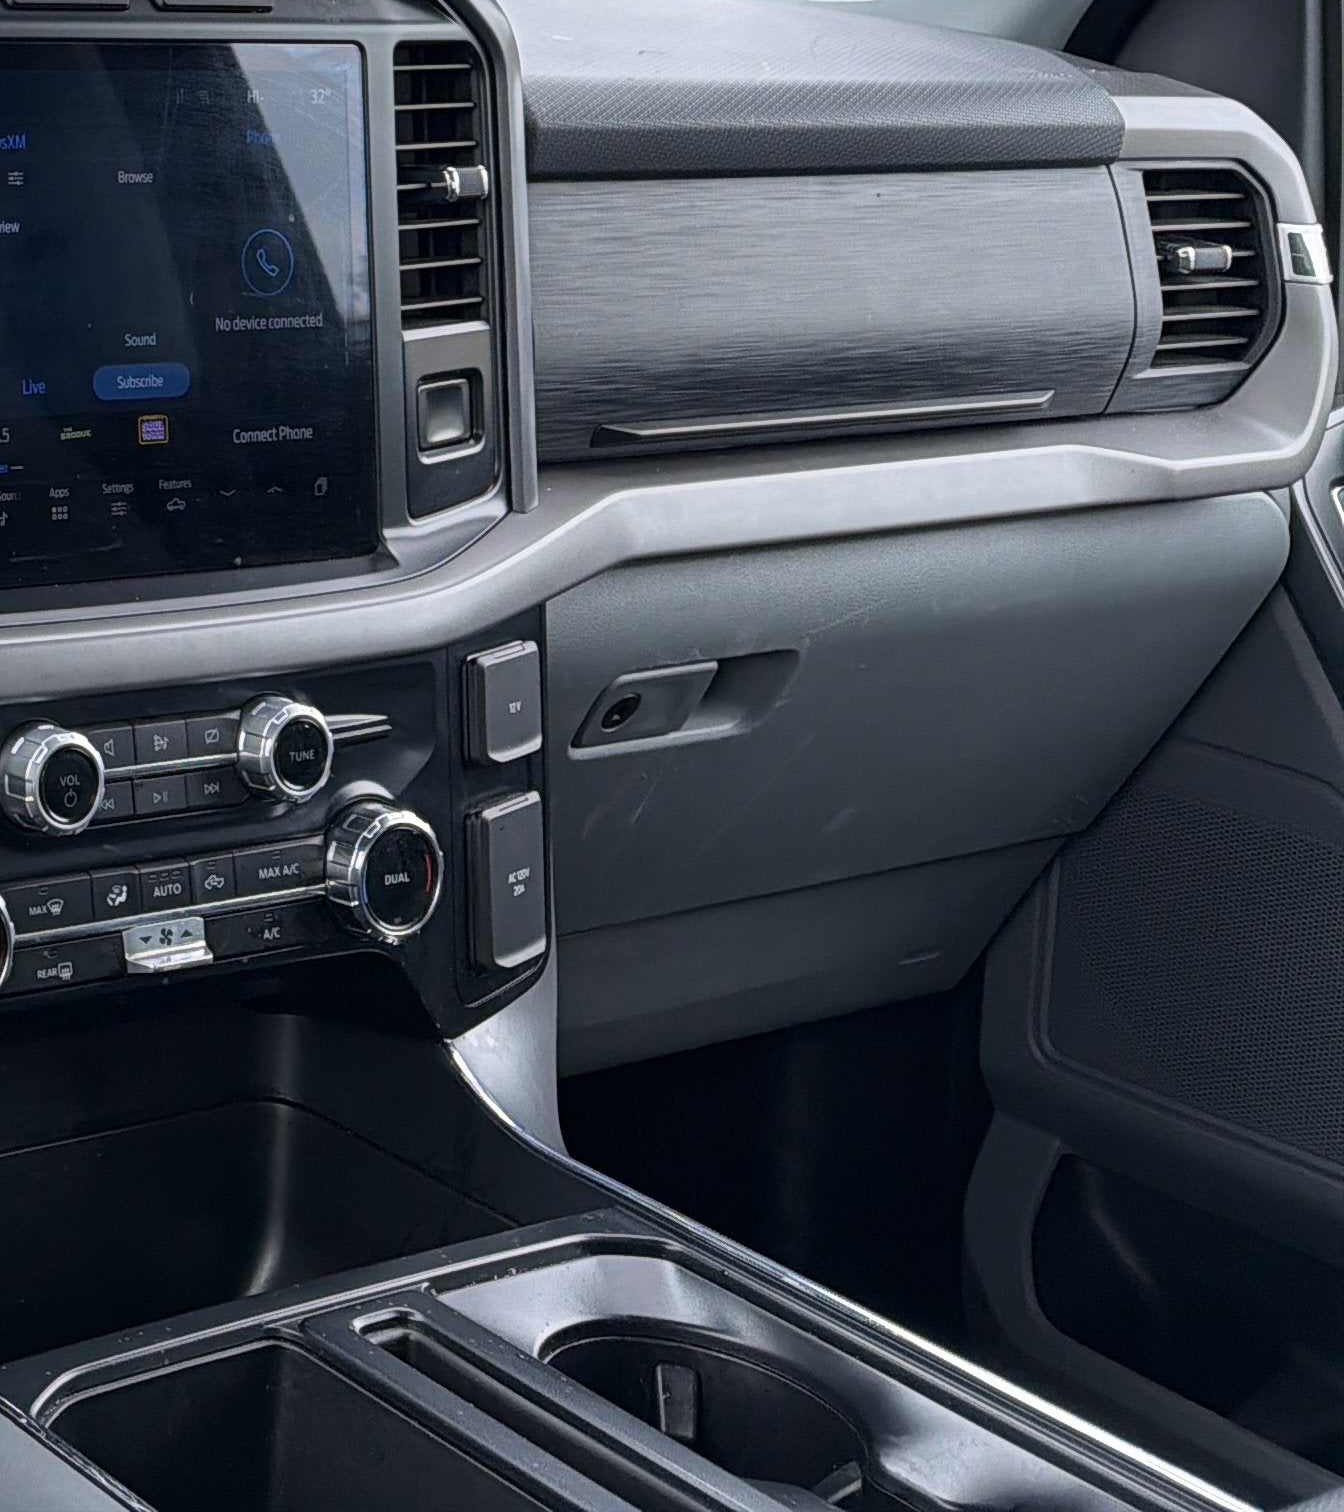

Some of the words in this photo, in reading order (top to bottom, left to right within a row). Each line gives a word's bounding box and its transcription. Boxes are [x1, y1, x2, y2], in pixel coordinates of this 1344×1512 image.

[117, 170, 154, 184] Browse
[215, 316, 230, 331] No
[232, 315, 267, 330] device
[268, 313, 323, 329] connected
[124, 333, 157, 347] Sound
[22, 380, 46, 395] Live
[117, 374, 164, 389] Subscribe
[233, 428, 277, 444] Connect
[279, 426, 313, 441] Phone
[102, 482, 135, 495] Settings
[159, 478, 192, 489] Features
[49, 487, 70, 499] Apps
[289, 749, 316, 763] TUNE
[59, 774, 81, 787] VOL
[258, 866, 281, 880] MAX
[282, 862, 300, 876] A/C
[384, 871, 410, 885] DUAL
[153, 884, 182, 898] AUTO
[29, 905, 48, 916] MAX
[263, 927, 280, 939] A/C
[36, 968, 58, 979] REAR
